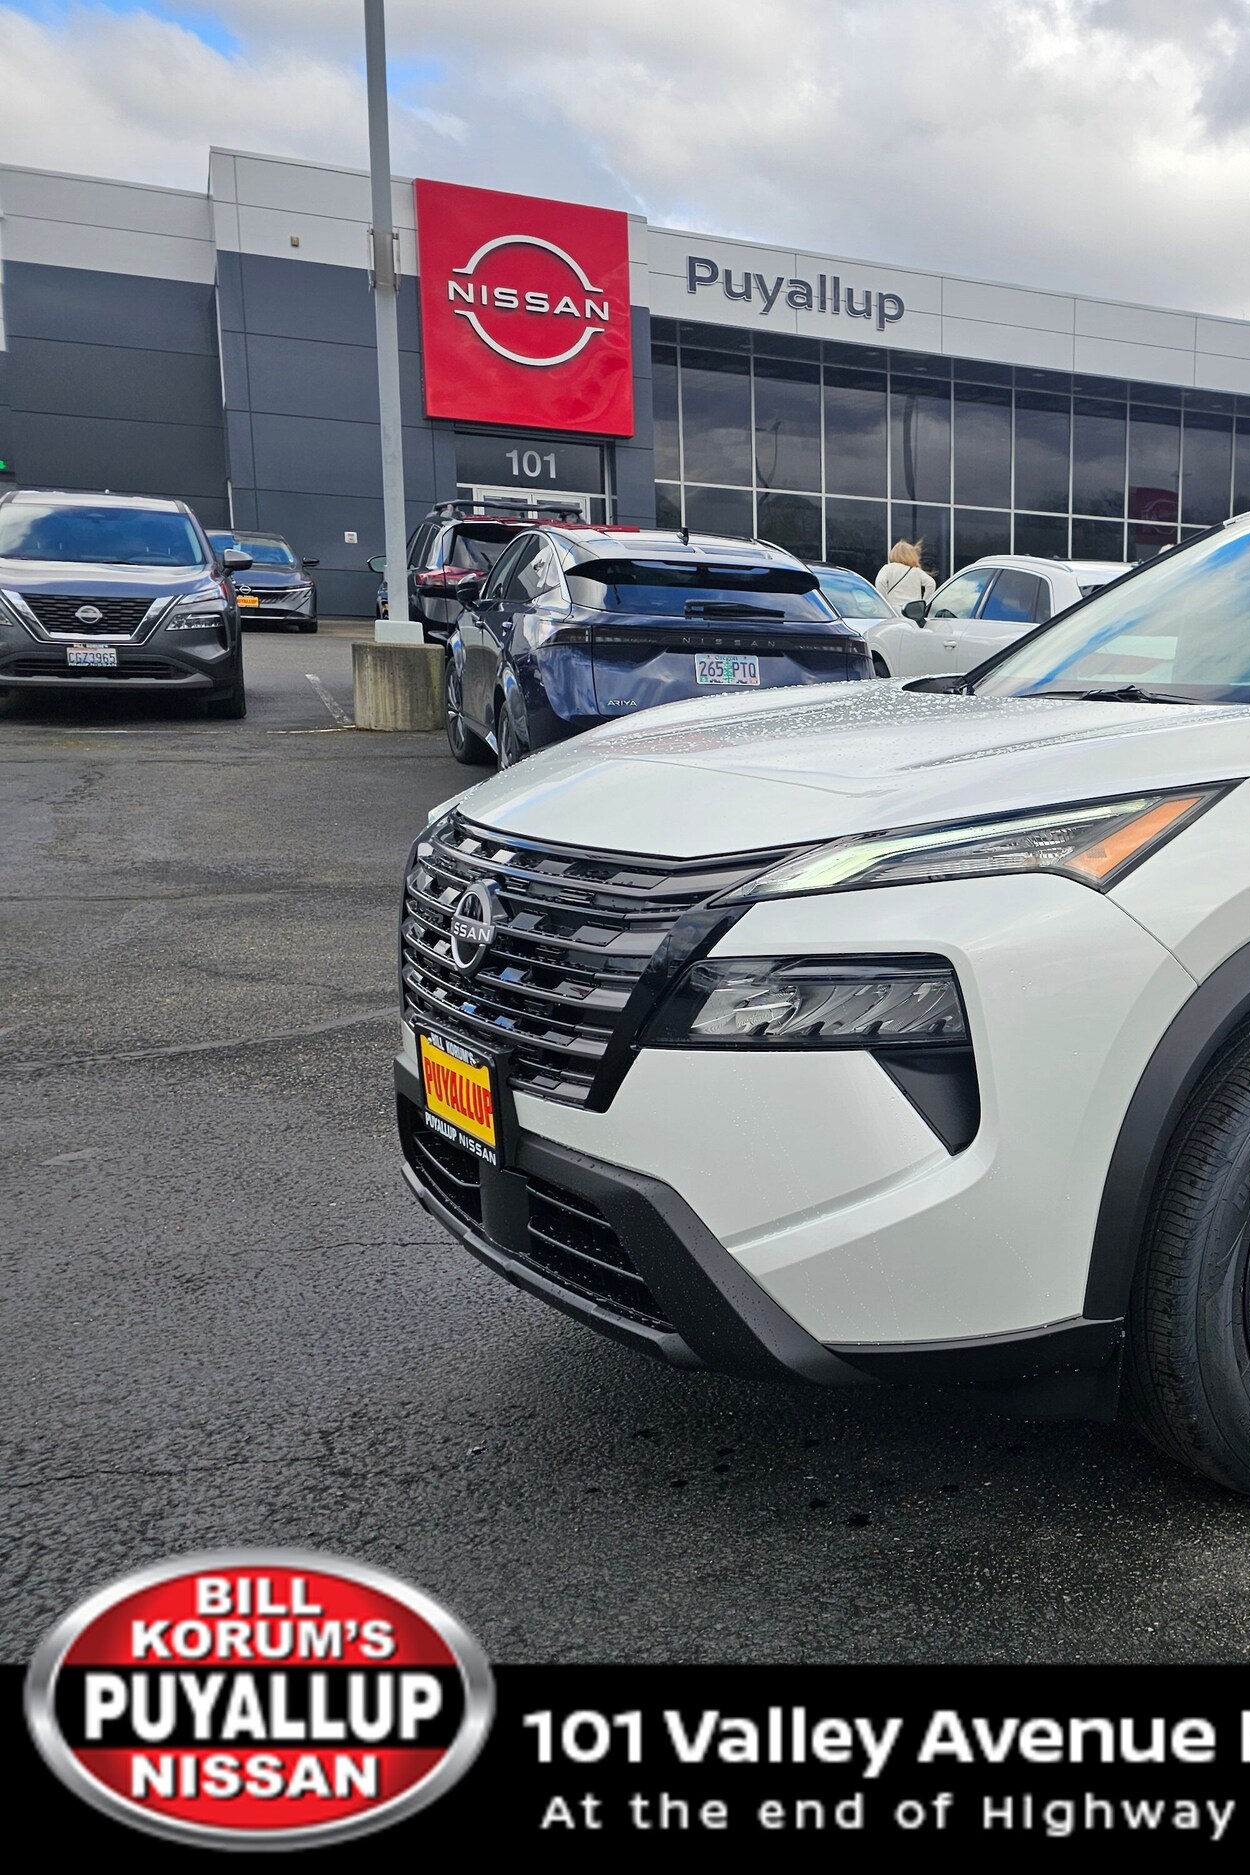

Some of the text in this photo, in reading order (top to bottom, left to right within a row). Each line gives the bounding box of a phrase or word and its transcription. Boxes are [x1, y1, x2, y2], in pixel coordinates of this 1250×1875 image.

[448, 280, 609, 321] NISSAN
[686, 255, 905, 331] Puyallup
[506, 450, 557, 479] 101
[682, 637, 775, 648] NISSAN
[699, 661, 756, 678] 265 PTQ
[607, 699, 637, 707] ARIYA
[453, 921, 491, 942] SSAN
[424, 1056, 494, 1129] PUYALLUP
[424, 1111, 497, 1166] PUYALLUP NISSAN
